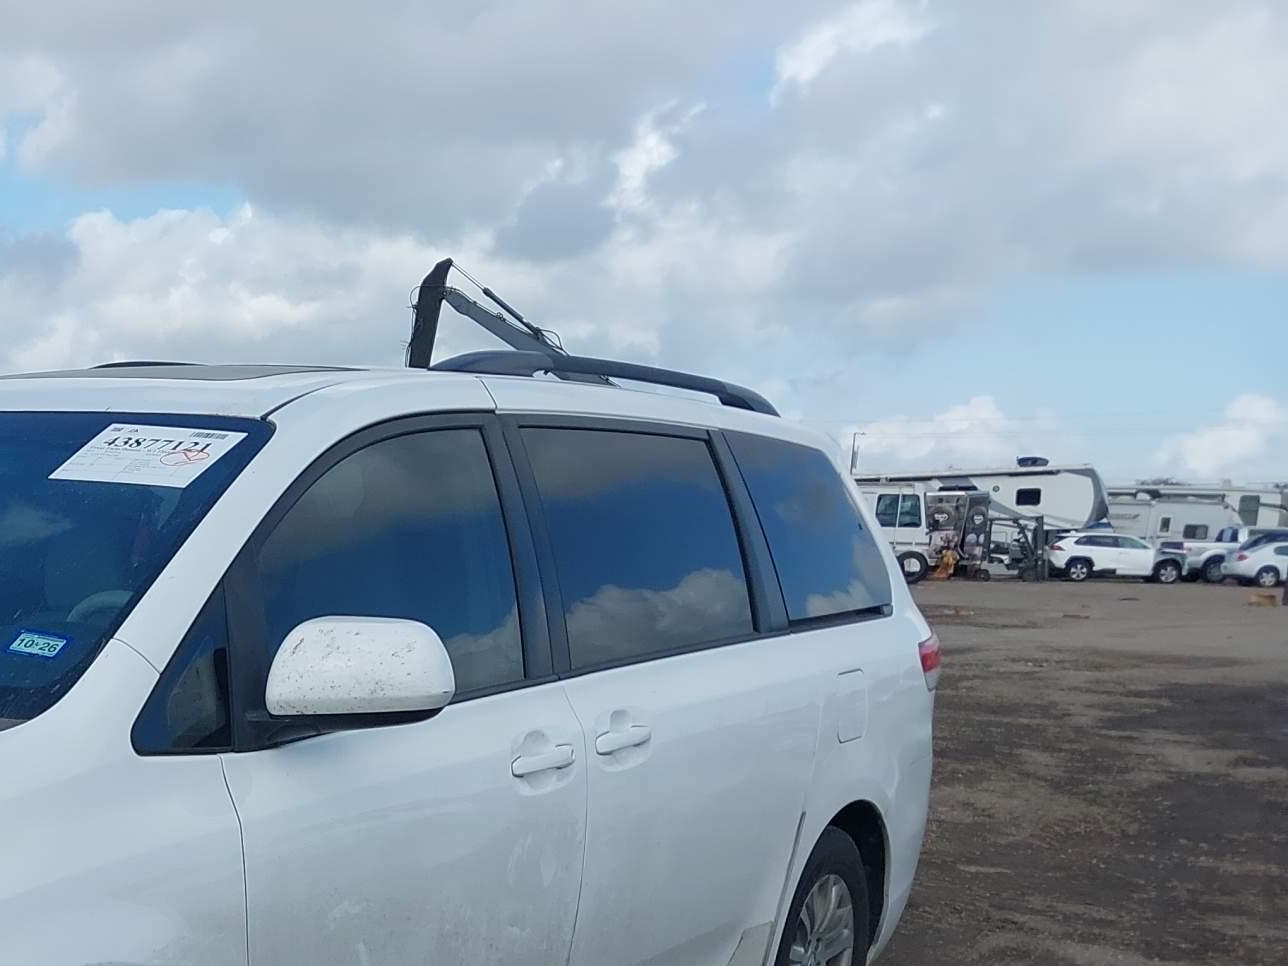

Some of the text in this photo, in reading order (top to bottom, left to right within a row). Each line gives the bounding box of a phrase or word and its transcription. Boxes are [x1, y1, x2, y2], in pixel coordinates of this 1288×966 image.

[103, 436, 212, 453] 43877121
[17, 638, 60, 653] 10 26
